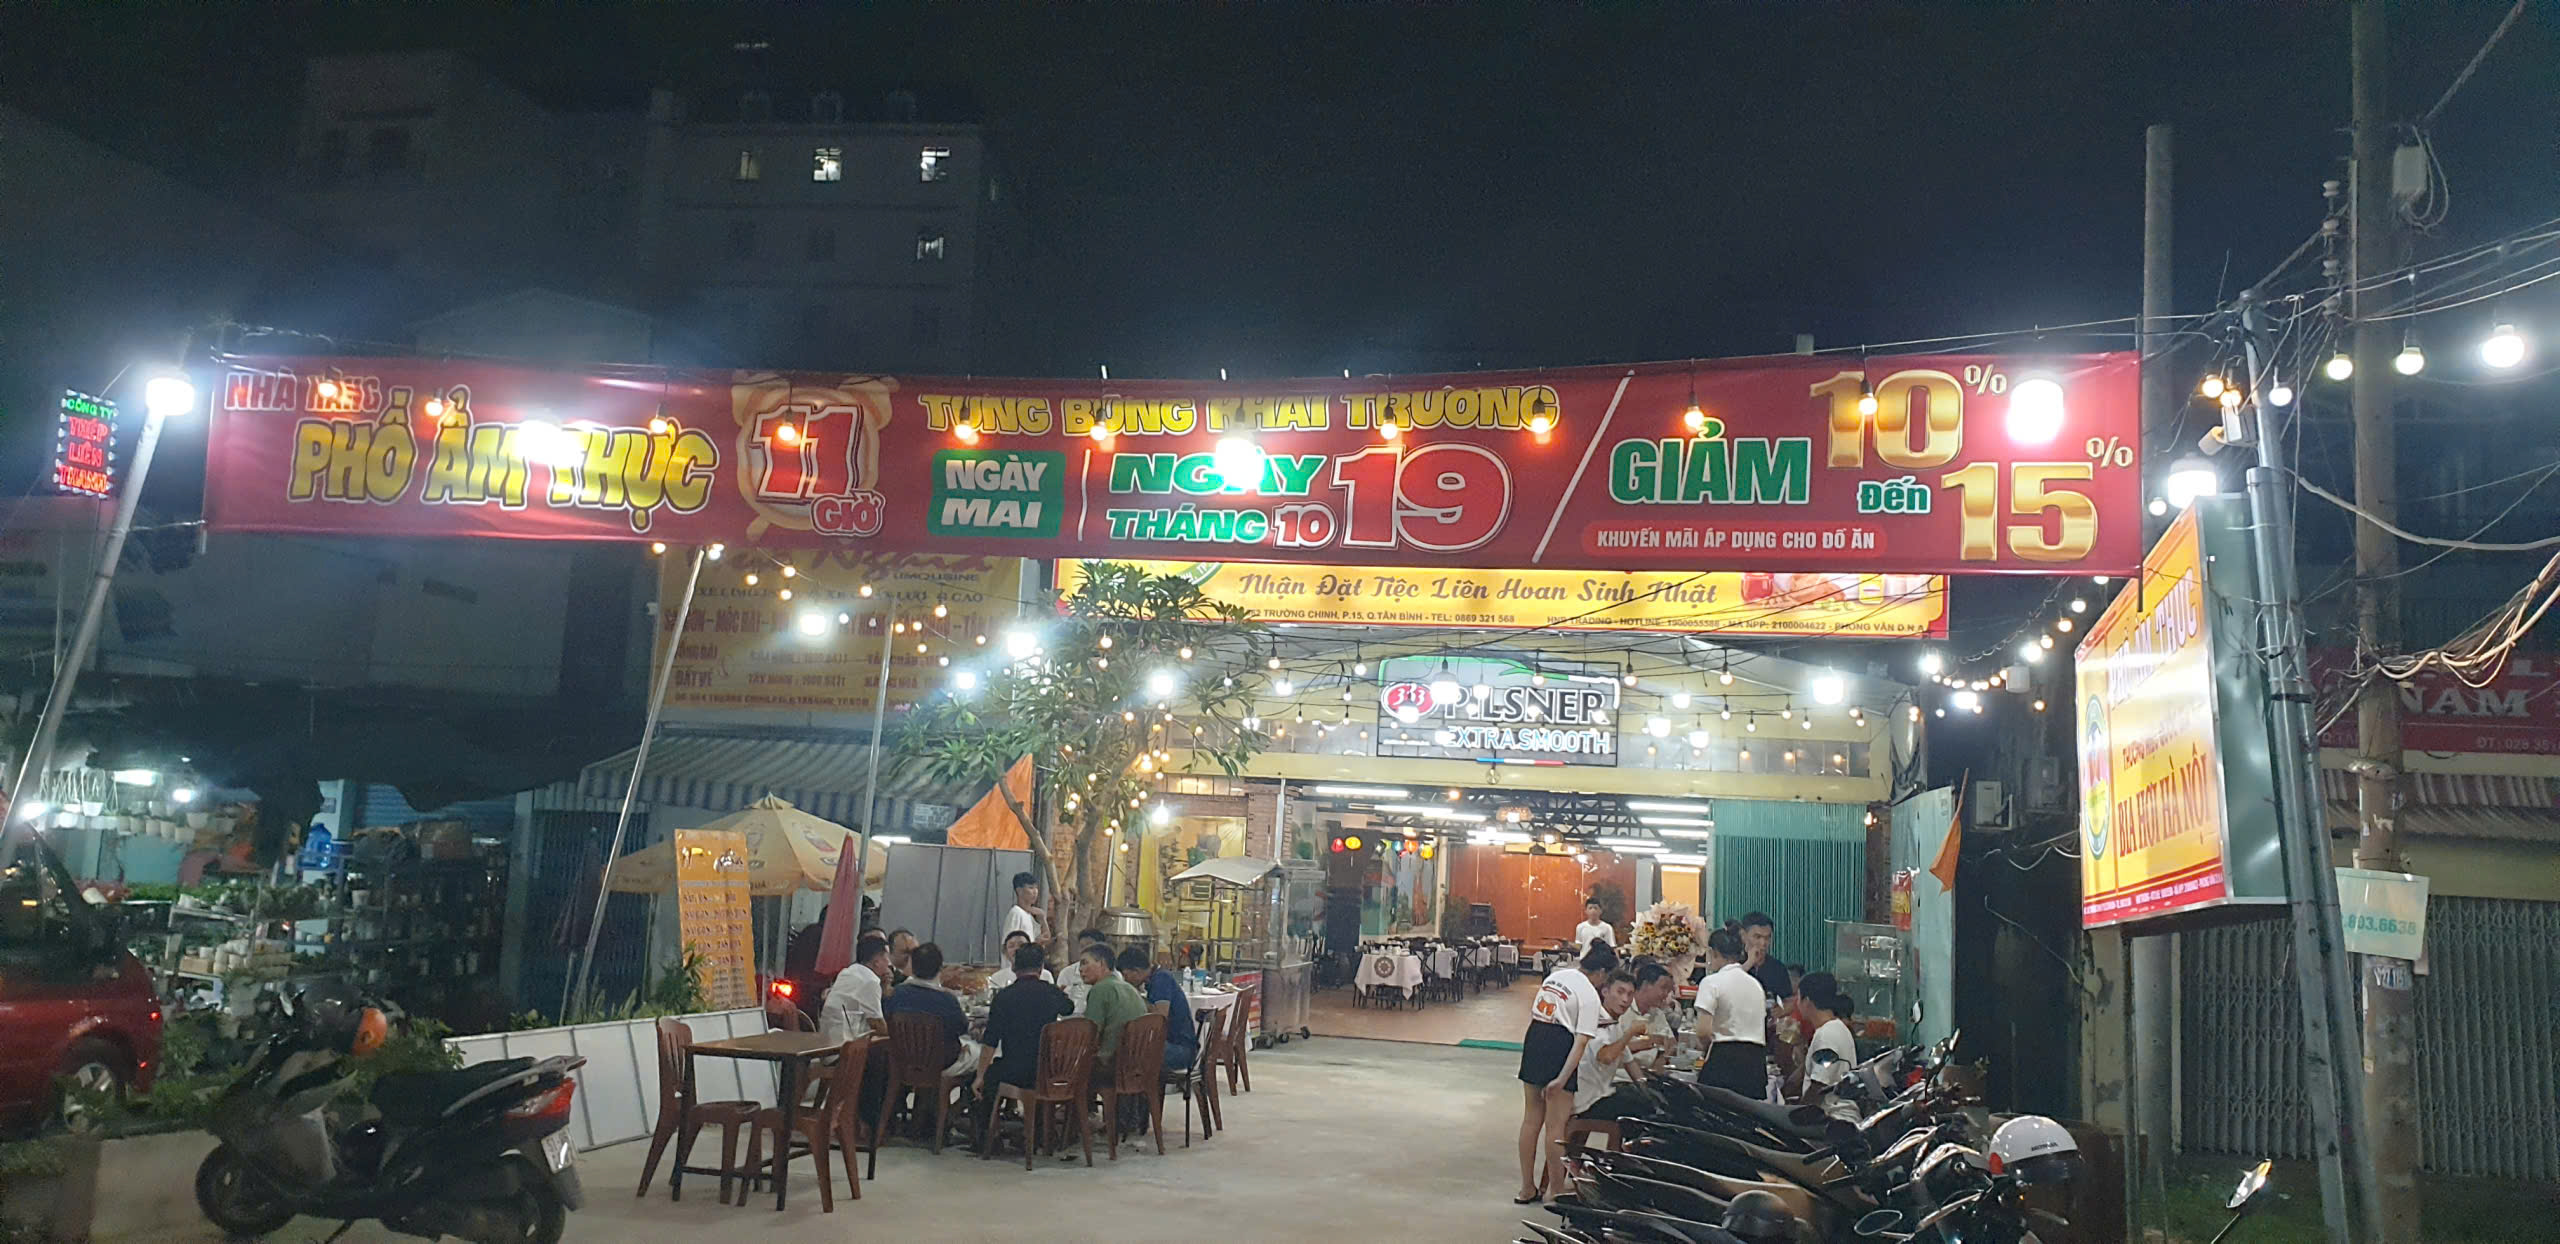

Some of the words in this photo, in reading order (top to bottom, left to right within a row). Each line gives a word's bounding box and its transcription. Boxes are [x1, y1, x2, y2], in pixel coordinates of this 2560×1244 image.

[67, 398, 98, 416] CÔNG
[100, 406, 113, 420] TY
[224, 368, 297, 411] NHÀ
[288, 386, 418, 504] PHỐ
[420, 384, 530, 510] ẨM
[751, 404, 864, 504] 11
[1608, 417, 1811, 504] GIẢM
[945, 455, 1047, 491] NGÀY
[811, 491, 886, 536] GIỜ
[941, 498, 1042, 528] MAI
[1328, 440, 1512, 552] 19
[1857, 475, 1931, 514] Đến
[1106, 503, 1268, 544] THÁNG
[1271, 501, 1337, 549] 10
[1597, 526, 1660, 548] KHUYẾN
[1665, 527, 1699, 548] MÃI
[1704, 527, 1726, 549] ÁP
[1731, 531, 1776, 552] DỤNG
[1782, 532, 1816, 549] CHO
[1851, 528, 1875, 550] ĂN
[1239, 573, 1306, 600] Nhận
[1315, 574, 1361, 602] Đặt
[1371, 576, 1420, 603] Tiệc
[1432, 577, 1489, 600] Liên
[1496, 578, 1567, 601] Hoan
[1576, 579, 1635, 602] Sinh
[1647, 581, 1717, 609] Nhật
[1264, 608, 1305, 619] TRƯỜNG
[1432, 613, 1452, 622] TEL:
[1480, 614, 1495, 623] 321
[1441, 686, 1611, 725] PLSNER
[2117, 796, 2138, 857] BIA
[2136, 781, 2160, 850] HƠI
[2159, 754, 2183, 841] HÀ
[2180, 741, 2208, 845] NỘI
